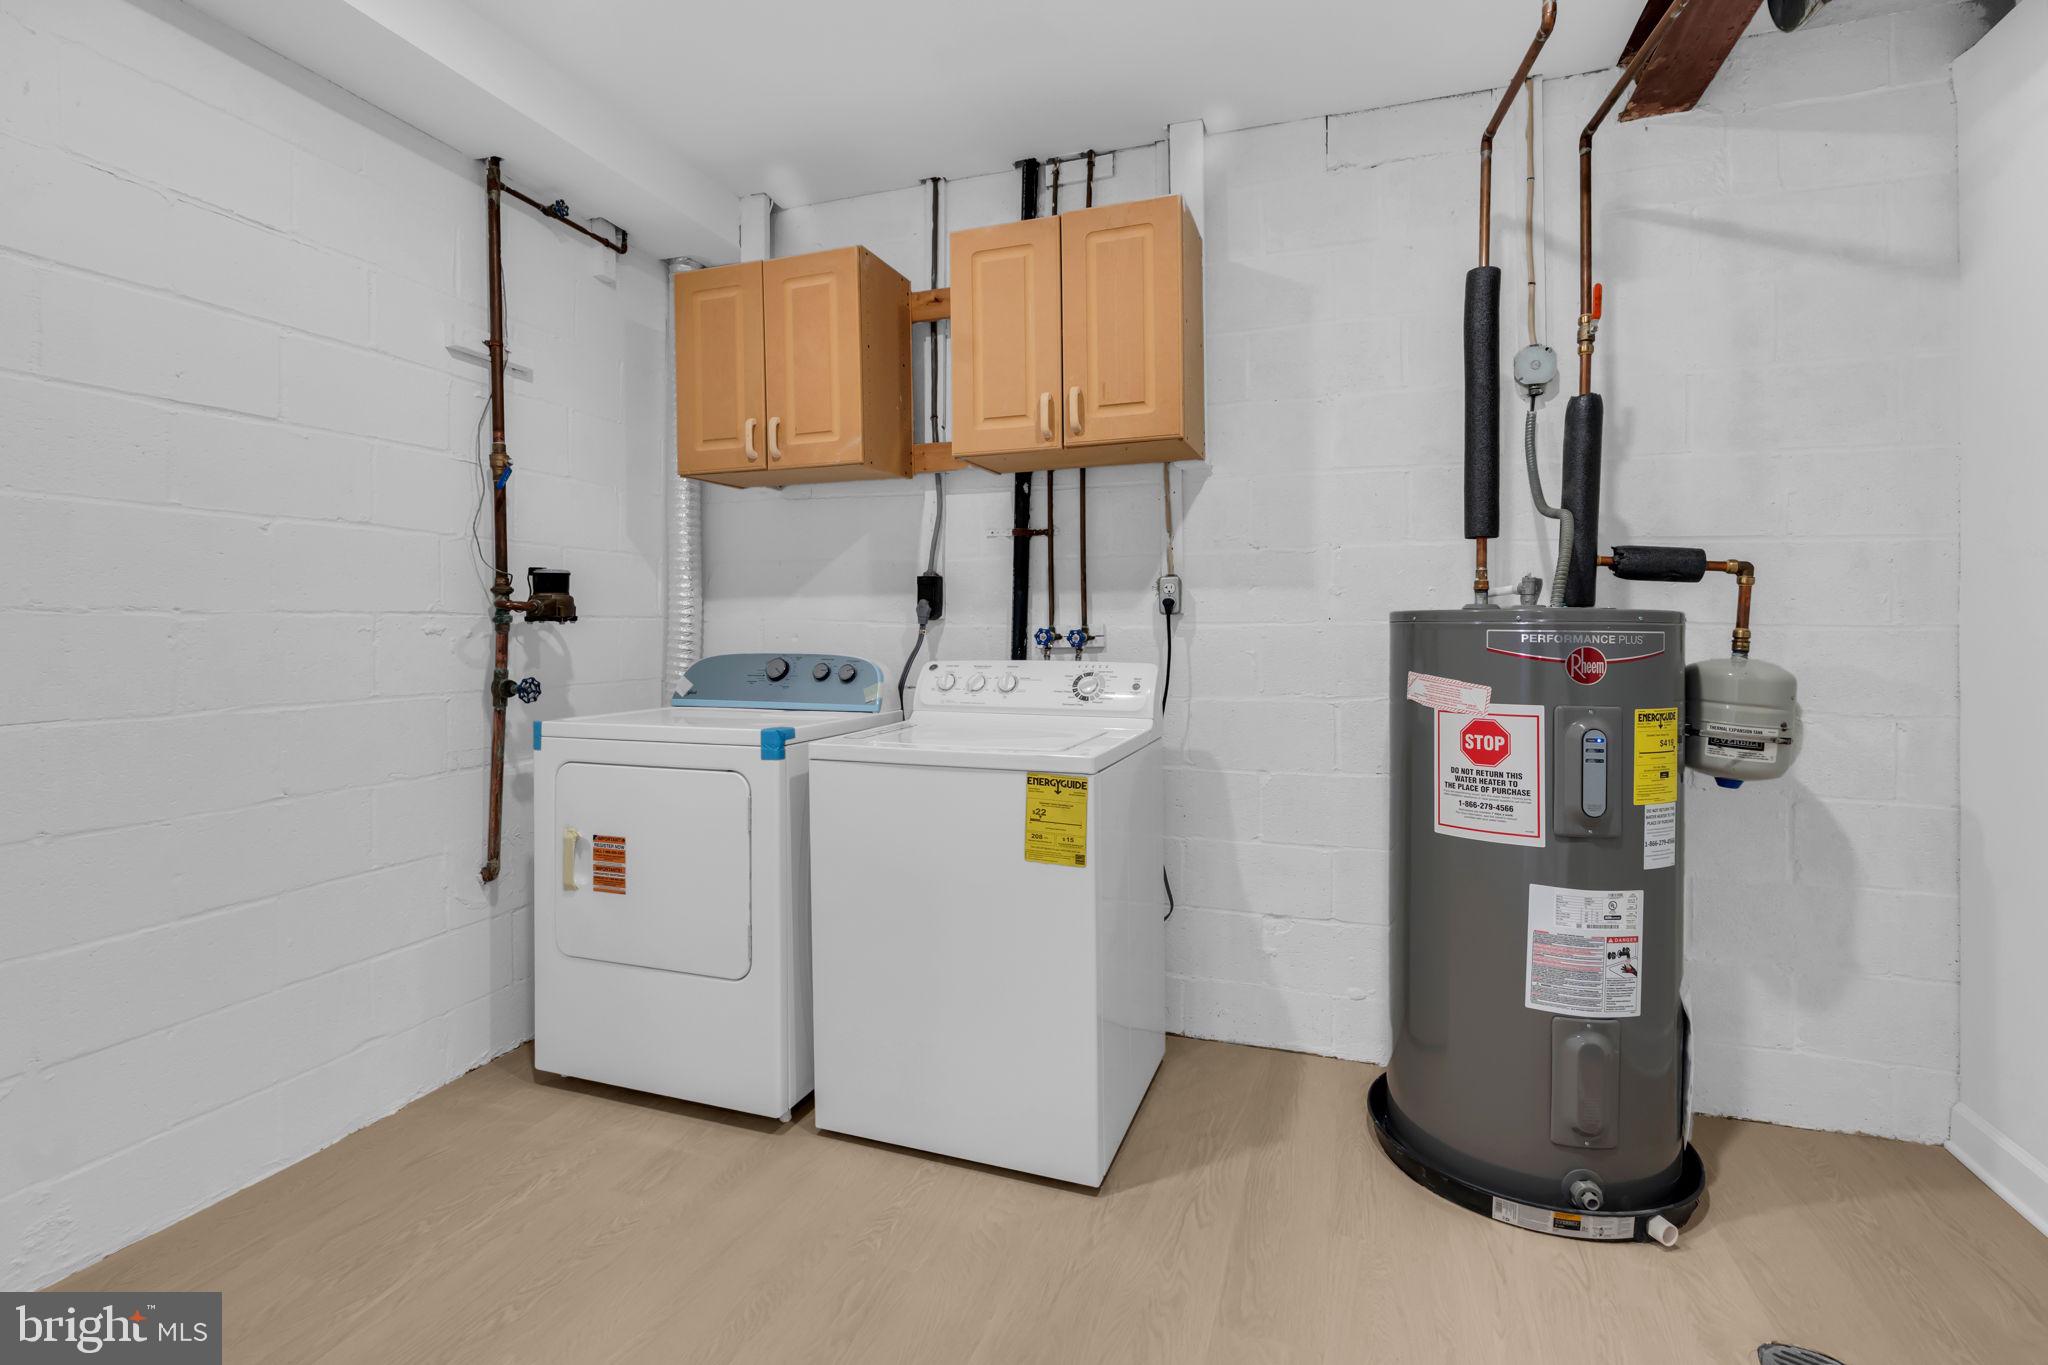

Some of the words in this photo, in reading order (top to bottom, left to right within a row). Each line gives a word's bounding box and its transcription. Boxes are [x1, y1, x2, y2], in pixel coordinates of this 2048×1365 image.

[1520, 633, 1616, 644] PERFORMANCE
[1618, 635, 1644, 645] PLUS
[1571, 647, 1605, 679] Rheem
[1638, 712, 1676, 722] ENERGYGUIDE
[1464, 733, 1505, 751] STOP
[1450, 766, 1459, 774] DO
[1460, 767, 1474, 776] NOT
[1475, 769, 1504, 779] RETURN
[1506, 772, 1523, 780] THIS
[1027, 776, 1088, 791] ENERGYGUIDE
[1454, 775, 1477, 784] WATER
[1478, 778, 1506, 787] HEATER
[1508, 780, 1518, 788] TO
[1444, 781, 1456, 790] THE
[1457, 783, 1479, 792] PLACE
[1480, 785, 1490, 794] OF
[1491, 787, 1531, 797] PURCHASE
[1458, 799, 1514, 813] 1-866-279-4566
